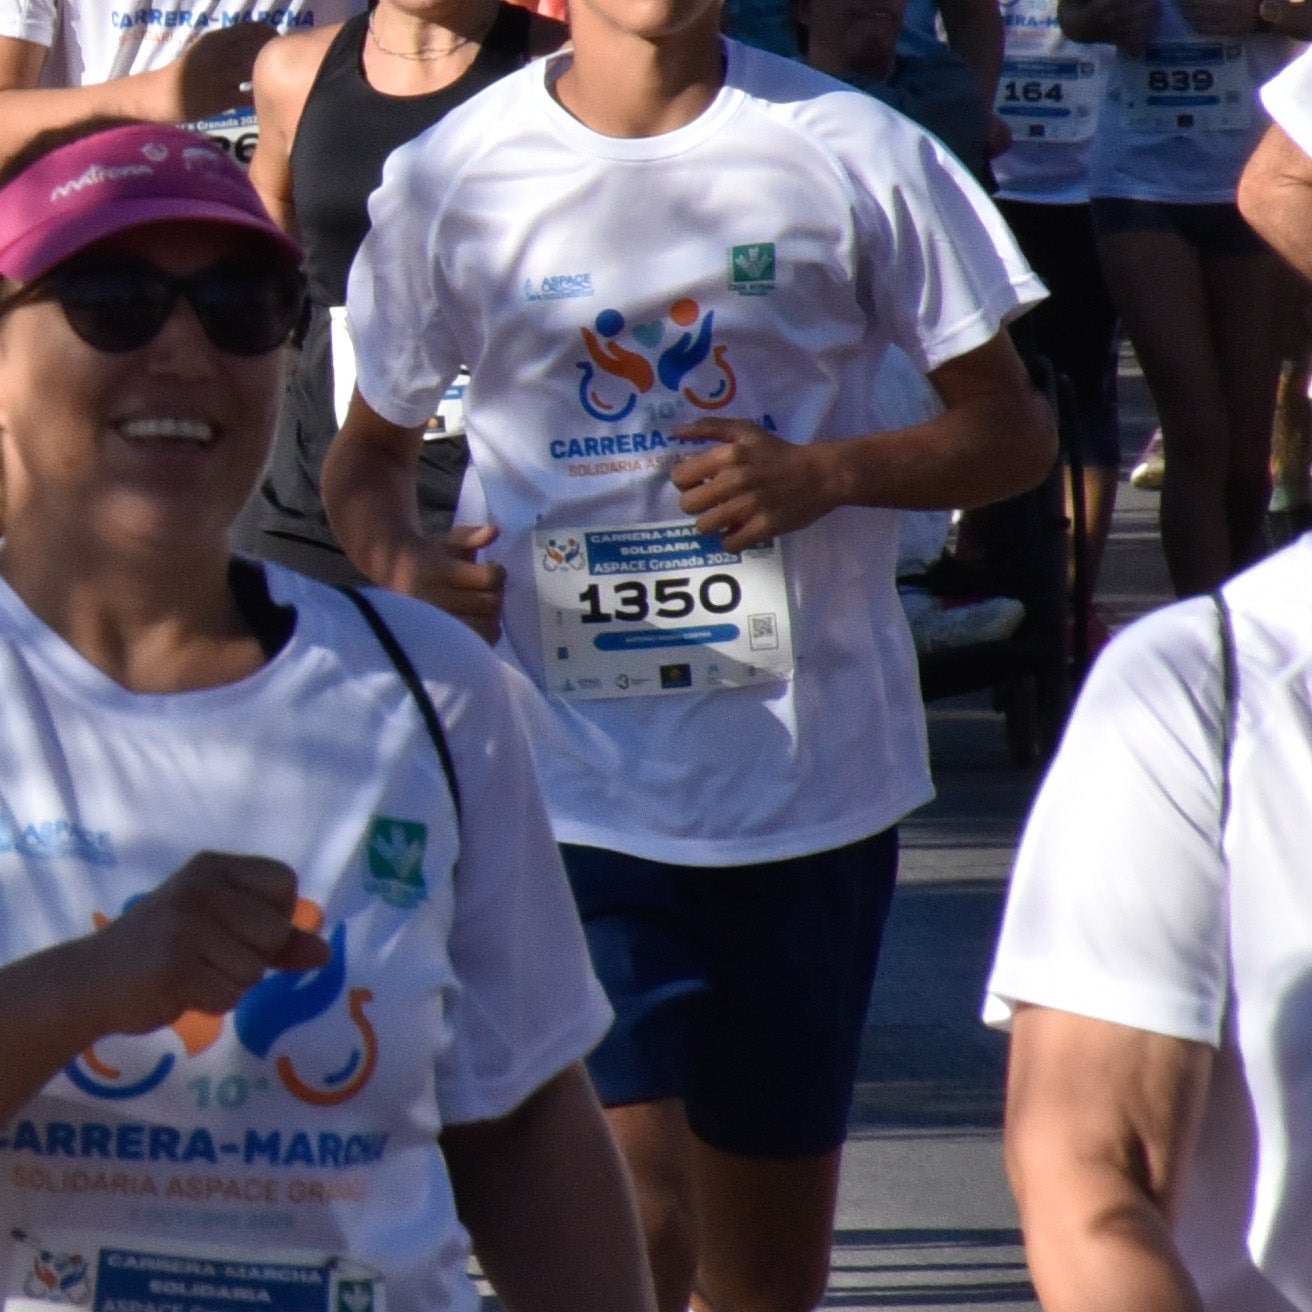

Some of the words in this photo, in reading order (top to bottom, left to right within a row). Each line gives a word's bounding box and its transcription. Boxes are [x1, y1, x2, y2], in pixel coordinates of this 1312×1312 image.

[1148, 68, 1214, 91] 839
[1003, 80, 1063, 103] 164
[541, 273, 591, 292] ASPACE
[620, 541, 702, 556] SOLIDARIA
[593, 559, 647, 574] ASPACE
[648, 554, 705, 570] Granada
[578, 573, 742, 624] 1350
[164, 1174, 276, 1203] ASPACE
